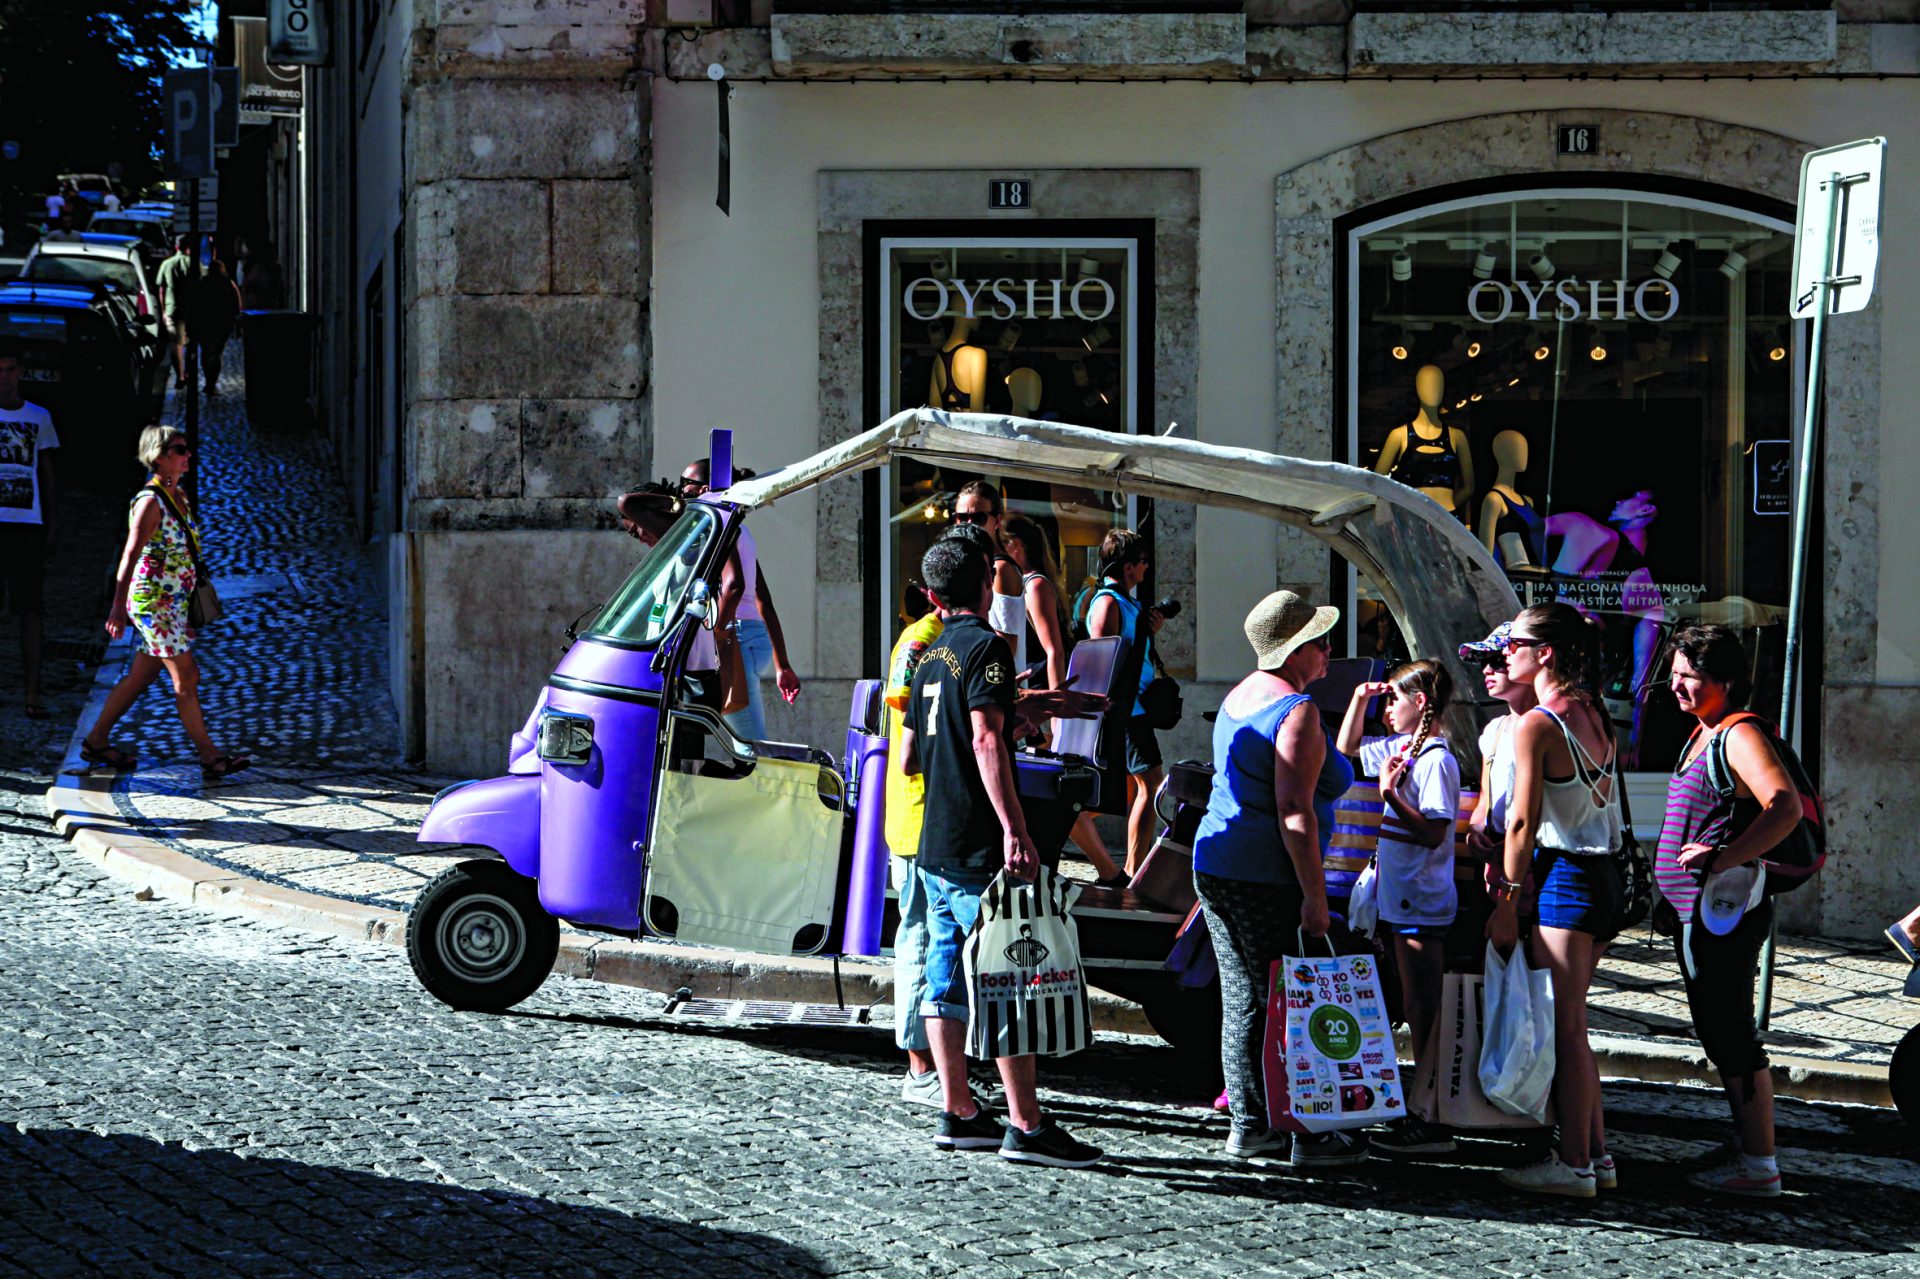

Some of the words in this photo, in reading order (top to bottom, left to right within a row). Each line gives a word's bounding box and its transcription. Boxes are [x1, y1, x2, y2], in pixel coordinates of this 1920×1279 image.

[174, 90, 198, 162] P
[1568, 128, 1589, 151] 16
[1000, 182, 1022, 205] 18
[904, 277, 1115, 320] OYSHO
[1467, 278, 1680, 323] OYSHO
[1558, 583, 1625, 592] NACIONAL
[1631, 583, 1707, 592] ESPANHOLA
[1628, 594, 1681, 606] RÍTMICA
[922, 681, 942, 736] 7
[980, 971, 1017, 988] Foot
[1022, 968, 1076, 986] Locker
[1326, 1019, 1348, 1036] 20
